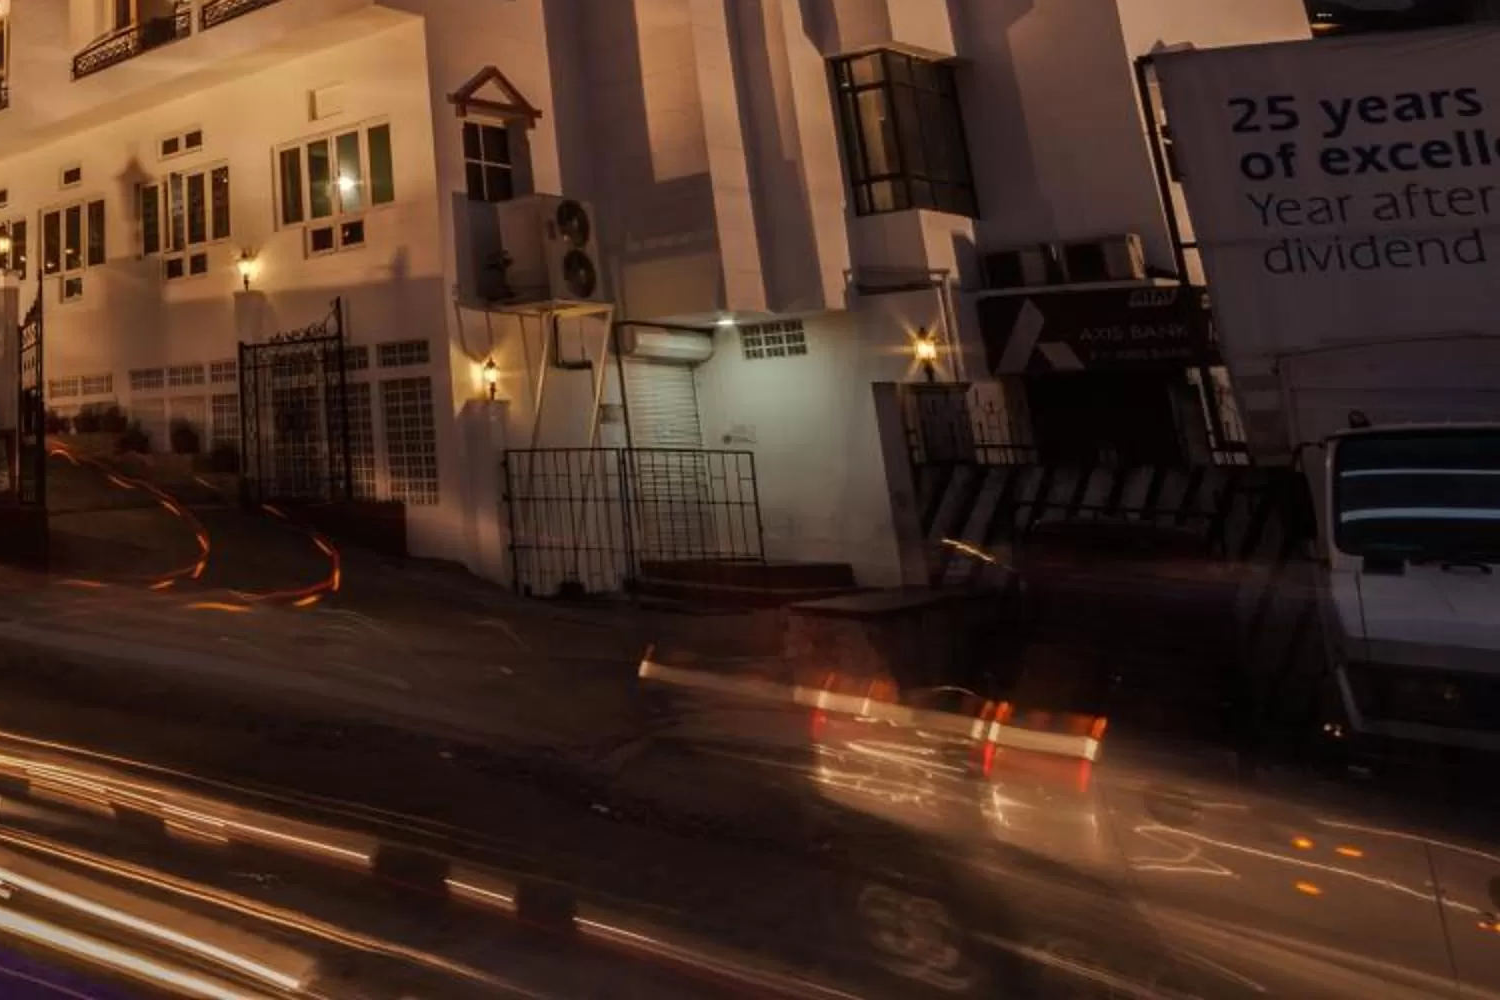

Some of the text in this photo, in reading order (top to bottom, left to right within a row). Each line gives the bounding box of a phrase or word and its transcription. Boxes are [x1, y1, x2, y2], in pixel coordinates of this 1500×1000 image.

[1228, 88, 1483, 139] 25 years
[1240, 142, 1299, 180] of
[1247, 183, 1497, 227] Year after
[1264, 229, 1487, 275] dividend
